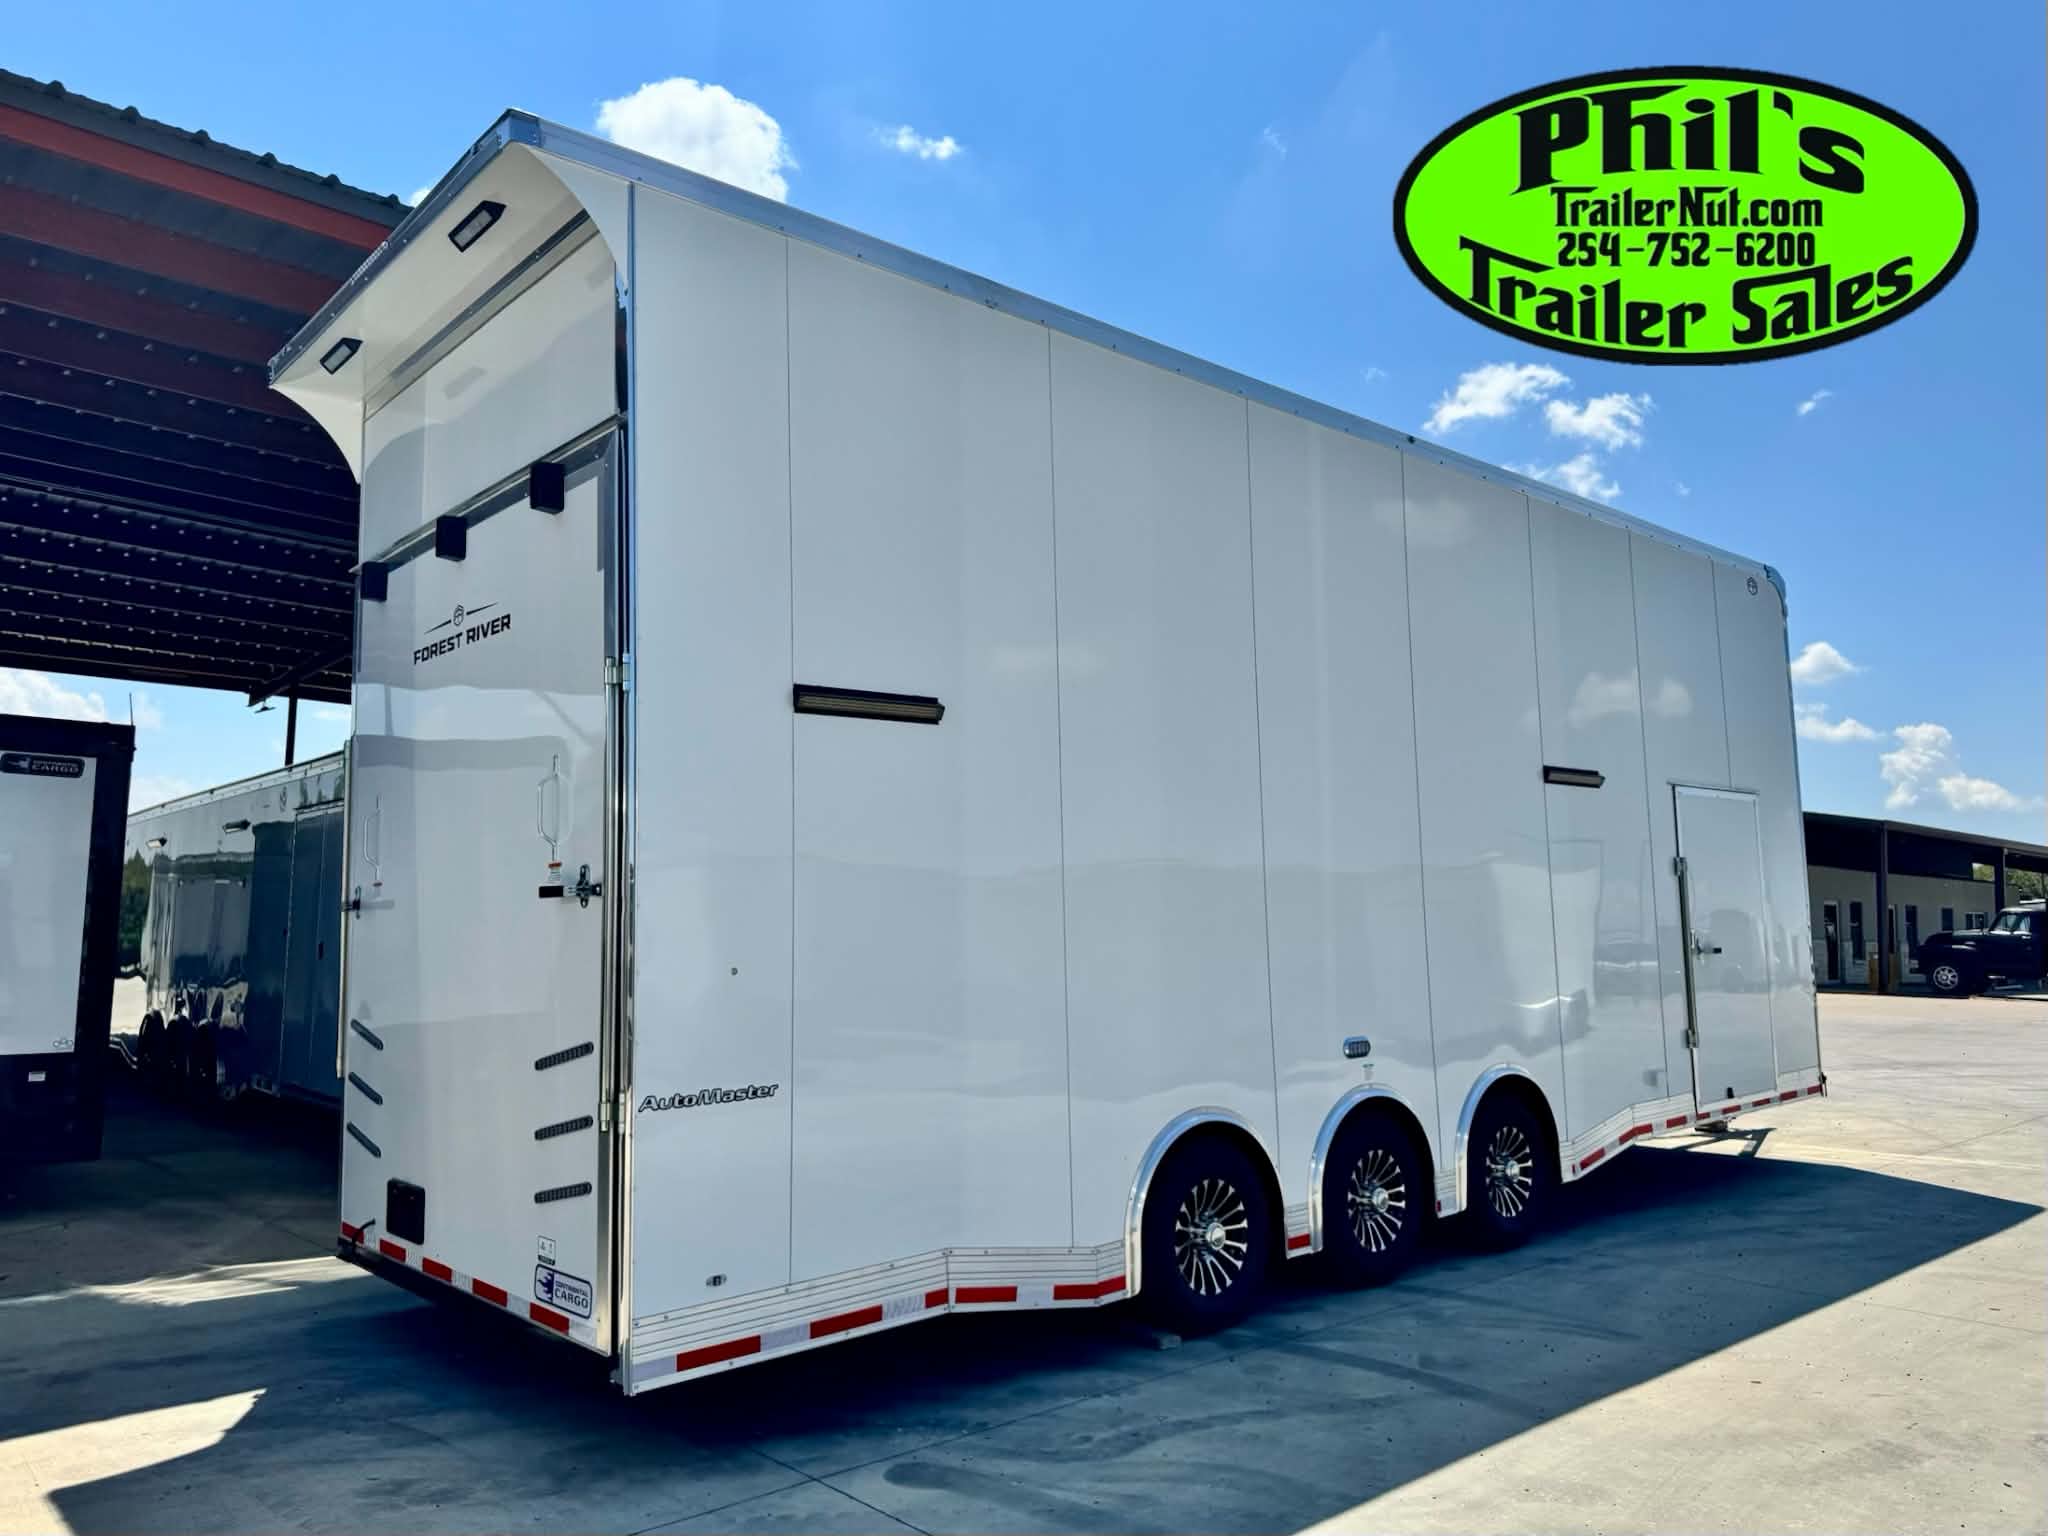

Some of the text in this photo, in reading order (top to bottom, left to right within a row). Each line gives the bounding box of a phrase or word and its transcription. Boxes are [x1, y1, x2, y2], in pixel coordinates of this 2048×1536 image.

[413, 614, 511, 665] FOREST RIVER
[638, 1083, 779, 1112] AutoMaster
[555, 1287, 588, 1309] CARGO
